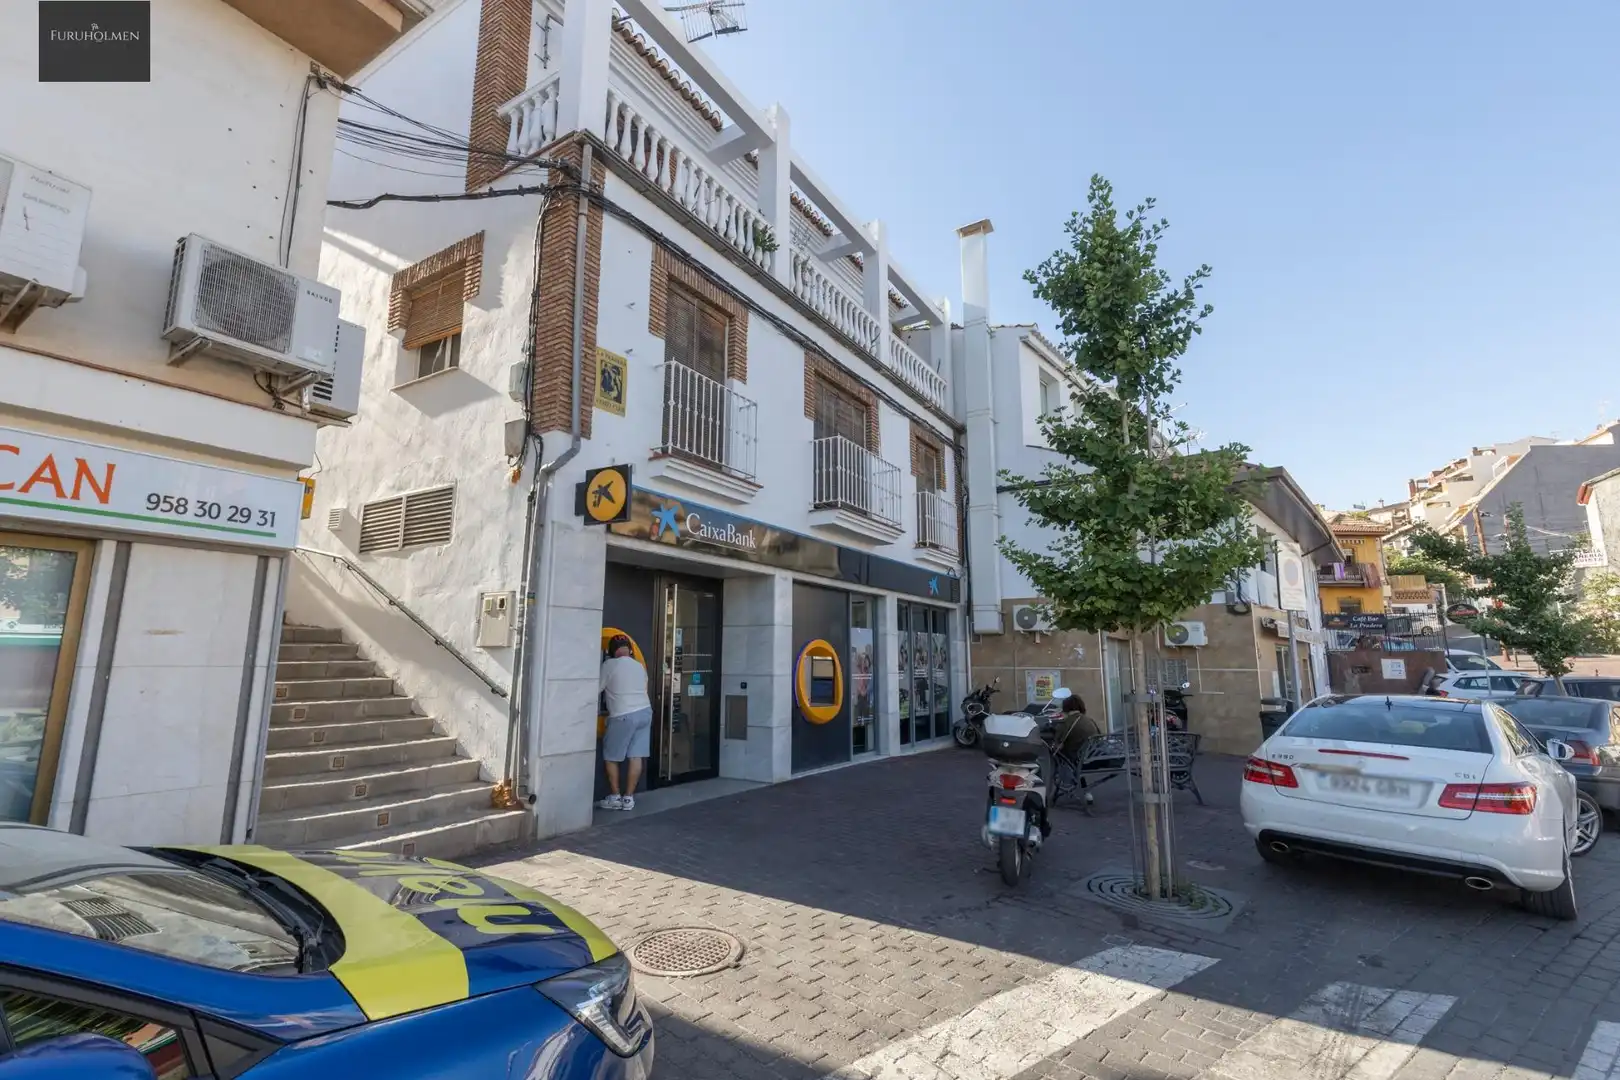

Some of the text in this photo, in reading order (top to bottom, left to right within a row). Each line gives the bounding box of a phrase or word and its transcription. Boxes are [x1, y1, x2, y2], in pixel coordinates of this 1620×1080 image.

[146, 492, 276, 528] 958 30 29 31
[686, 512, 756, 548] CaixaBank
